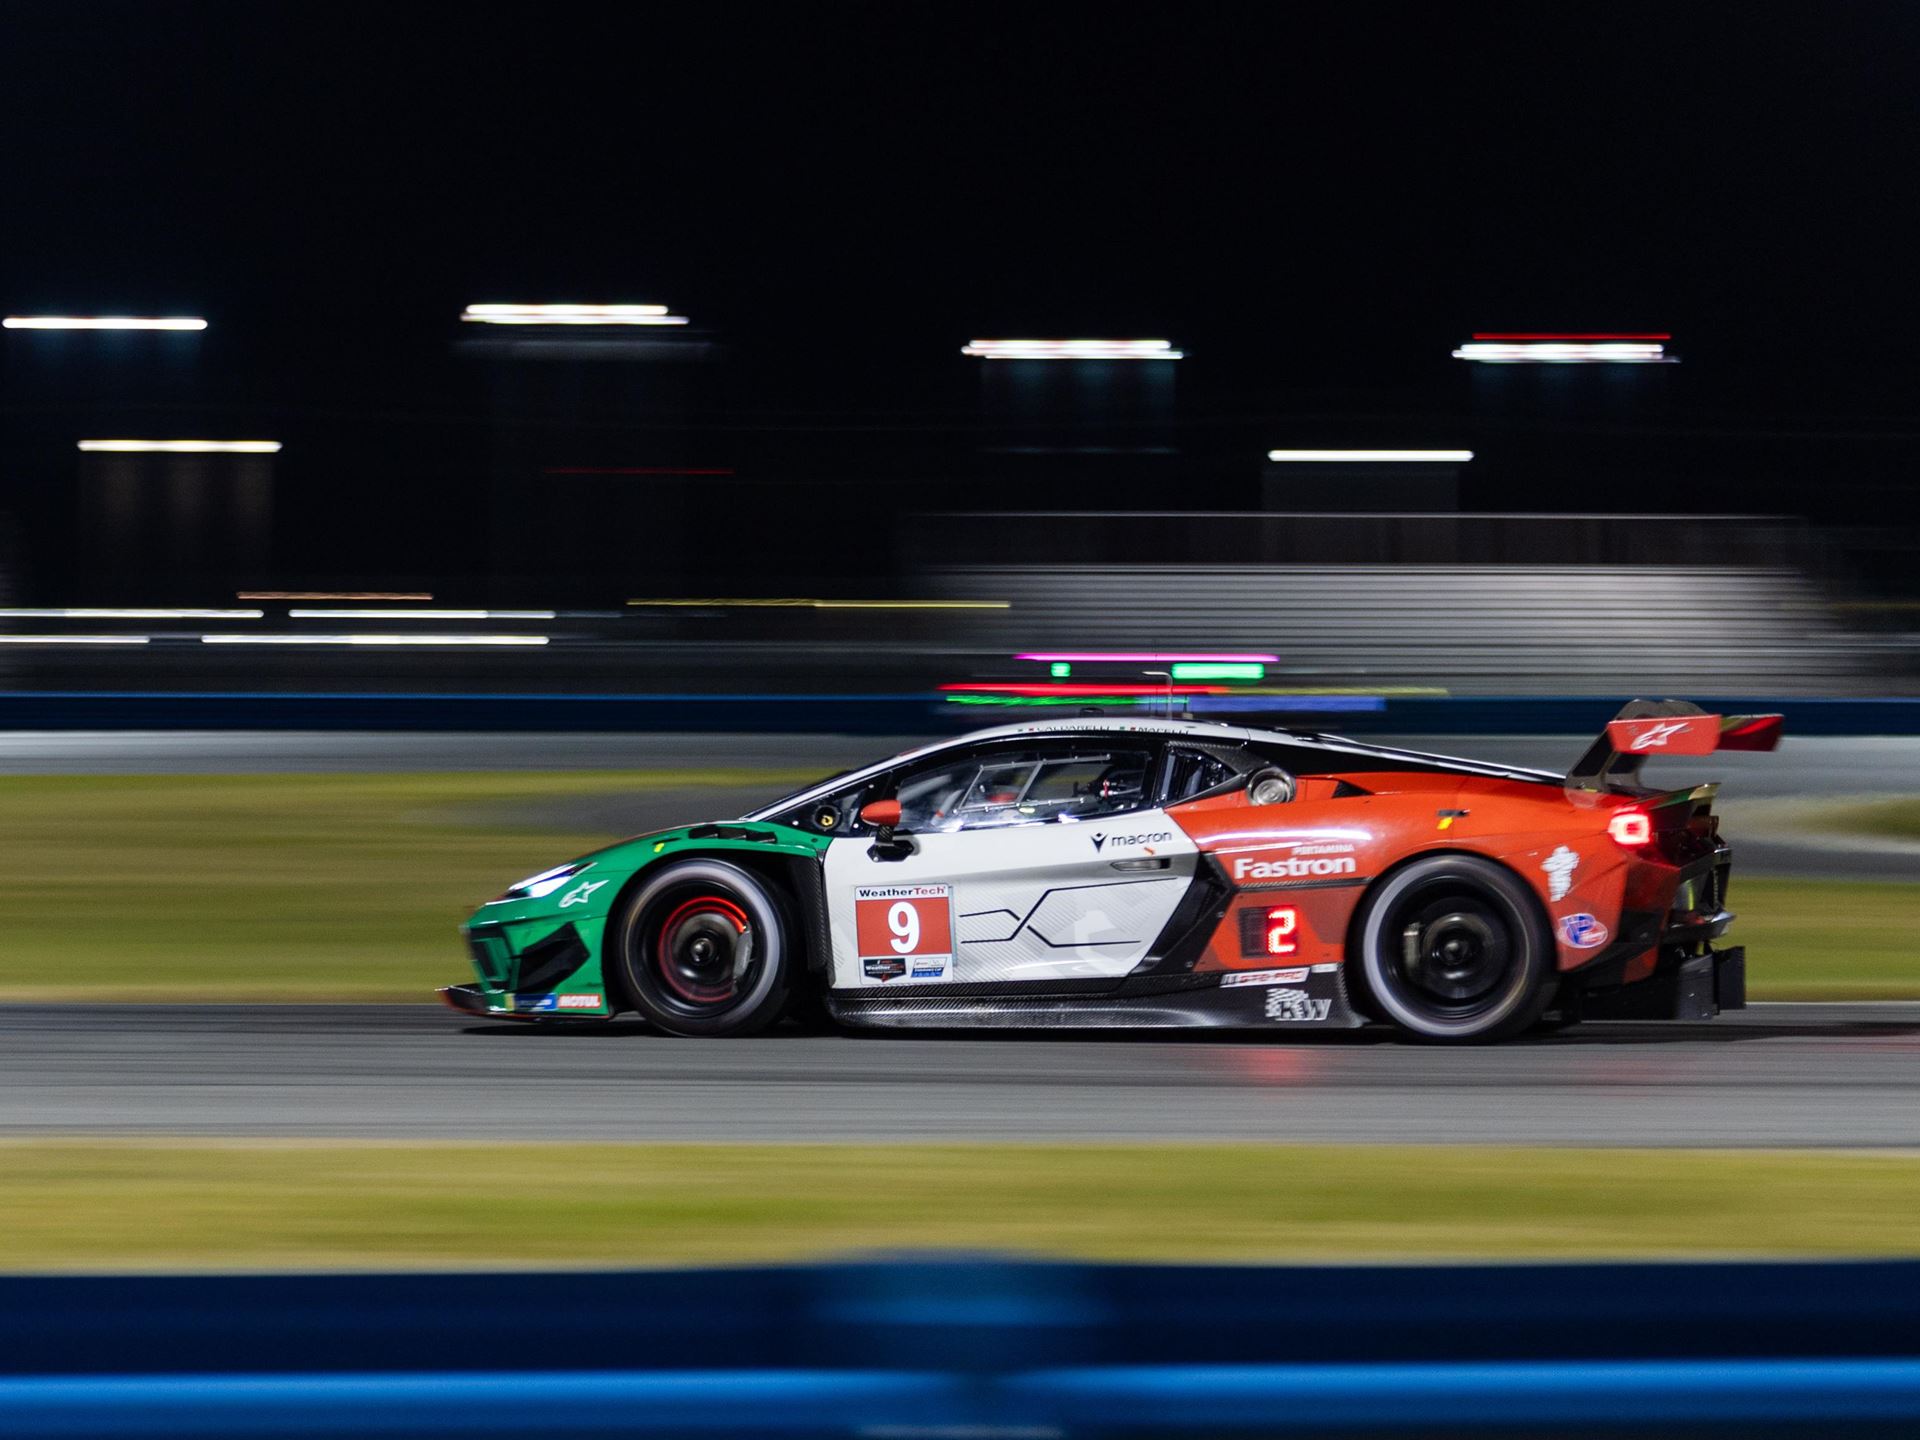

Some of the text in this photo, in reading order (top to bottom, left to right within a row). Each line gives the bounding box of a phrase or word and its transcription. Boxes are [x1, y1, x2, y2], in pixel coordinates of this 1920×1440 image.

[1111, 832, 1172, 846] macron
[1234, 857, 1356, 879] Fastron
[887, 901, 920, 954] 9
[1268, 909, 1296, 953] 2
